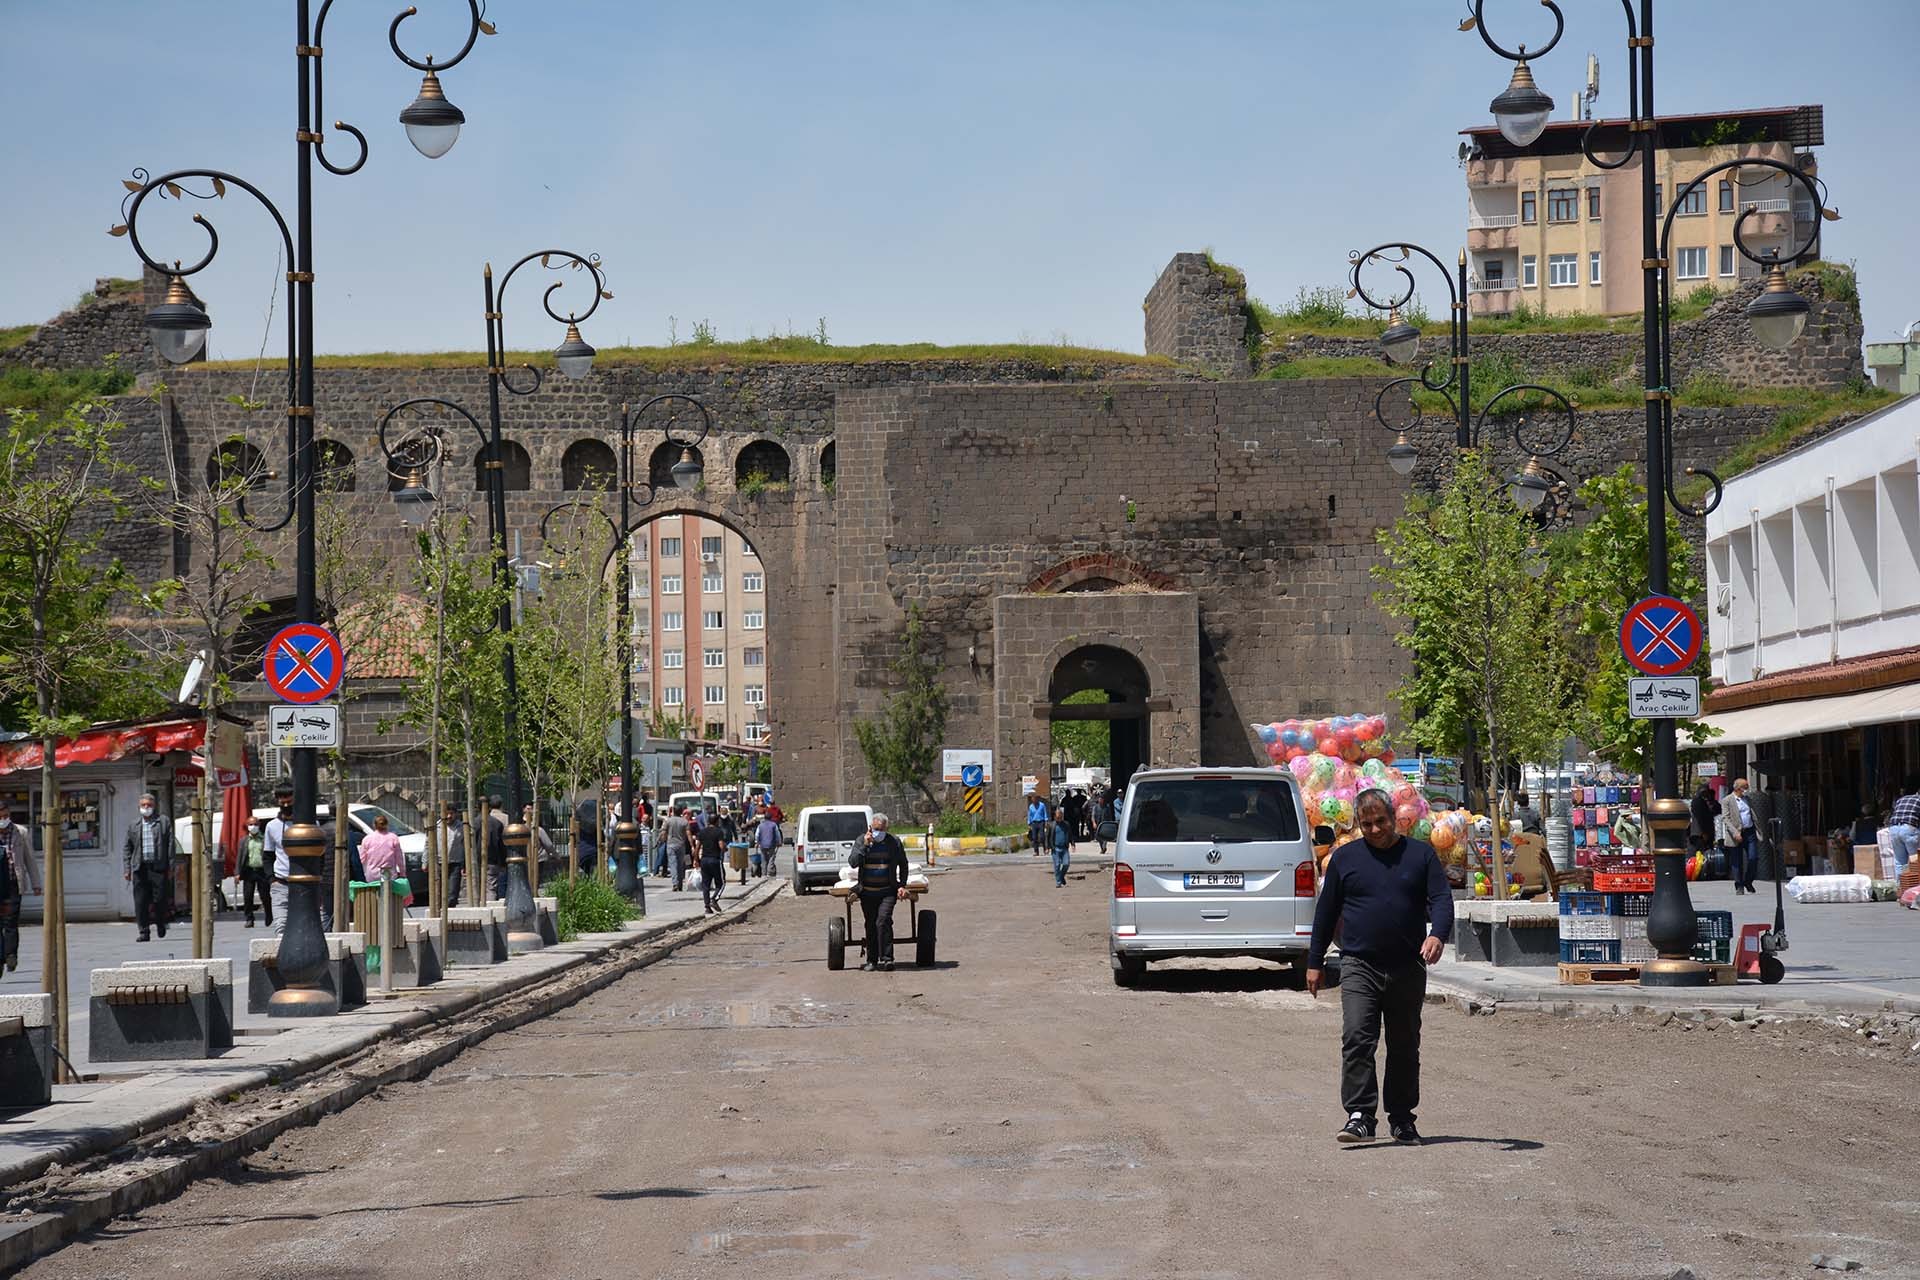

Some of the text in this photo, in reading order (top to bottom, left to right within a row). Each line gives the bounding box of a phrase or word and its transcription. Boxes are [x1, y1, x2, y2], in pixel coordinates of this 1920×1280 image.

[1638, 705, 1659, 713] Araç
[1191, 874, 1240, 885] 21 EH 200
